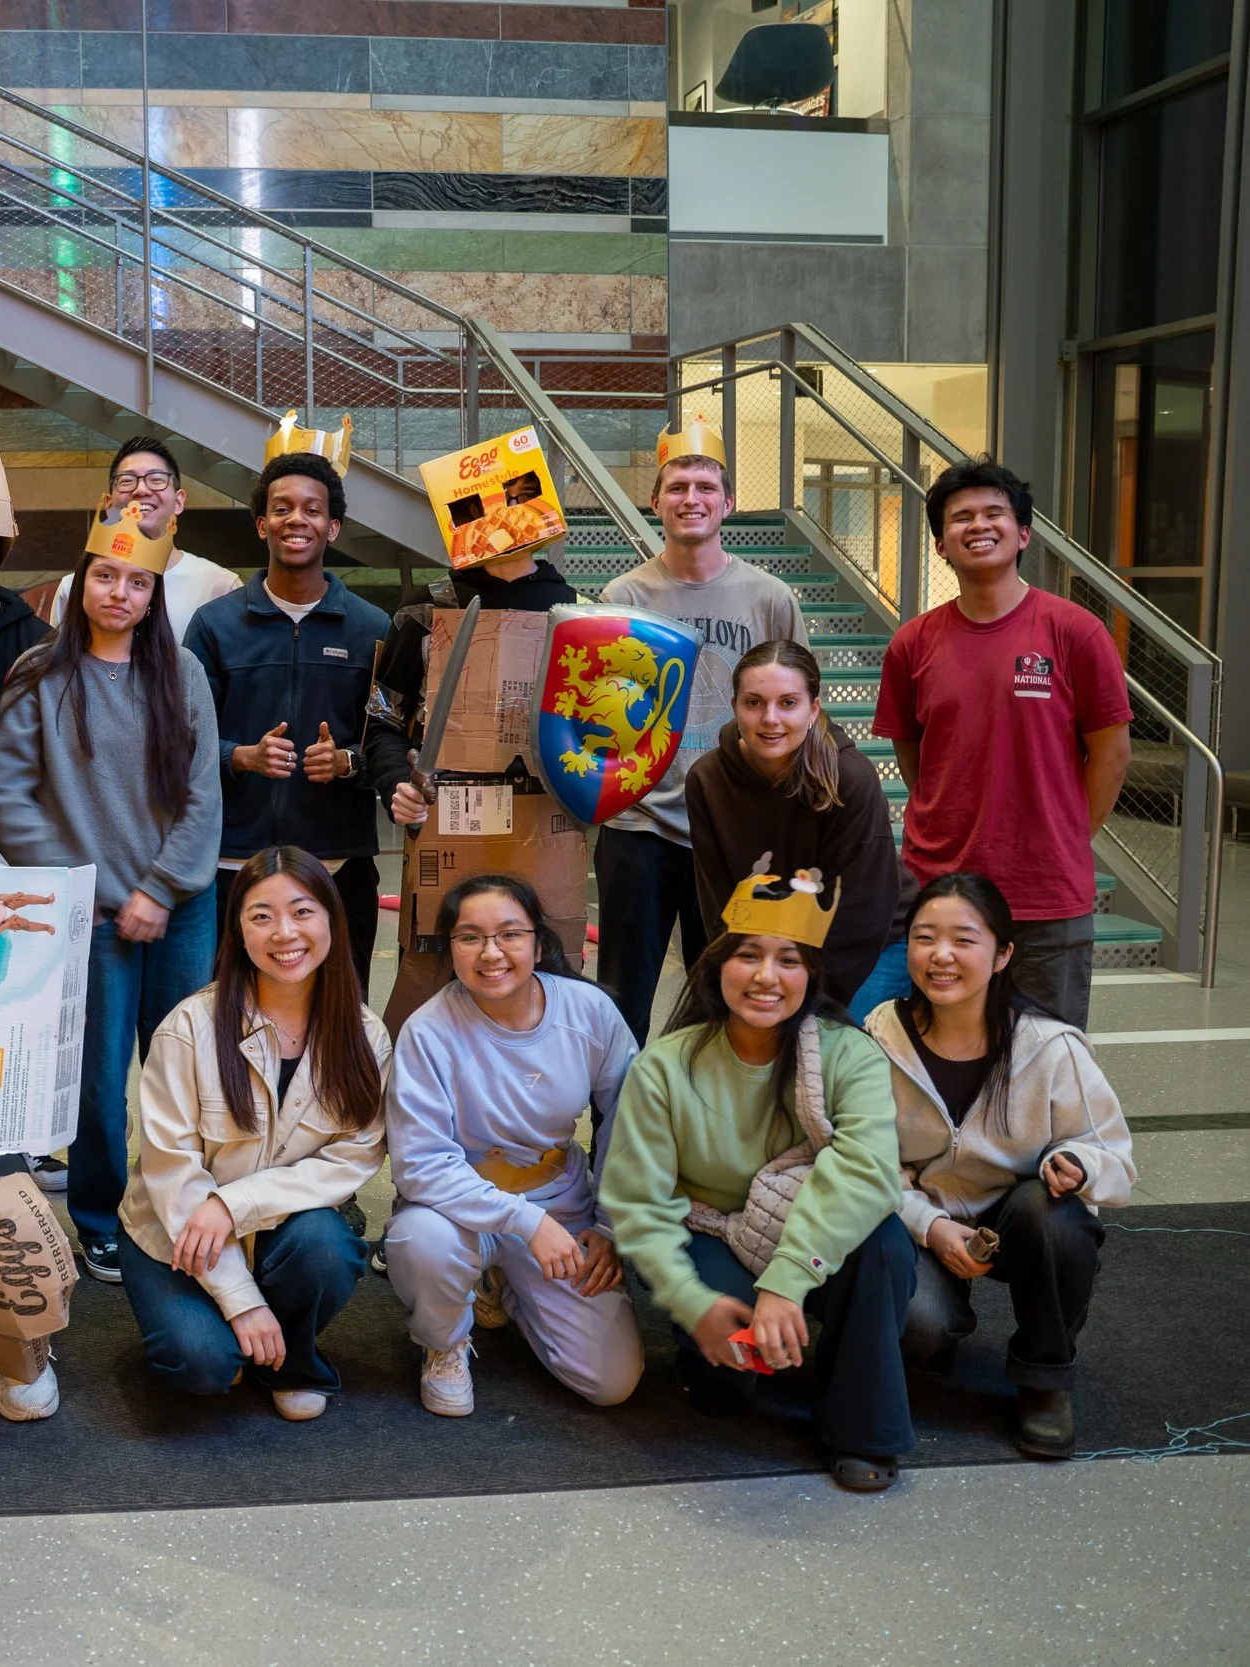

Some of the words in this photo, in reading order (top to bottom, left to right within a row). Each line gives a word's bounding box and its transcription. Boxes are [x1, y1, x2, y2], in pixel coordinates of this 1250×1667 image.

[513, 435, 528, 447] 60
[459, 447, 499, 480] Eggo
[453, 469, 519, 498] Homestyle
[1014, 674, 1051, 685] NATIONAL
[18, 1190, 69, 1282] REFRIGERATED
